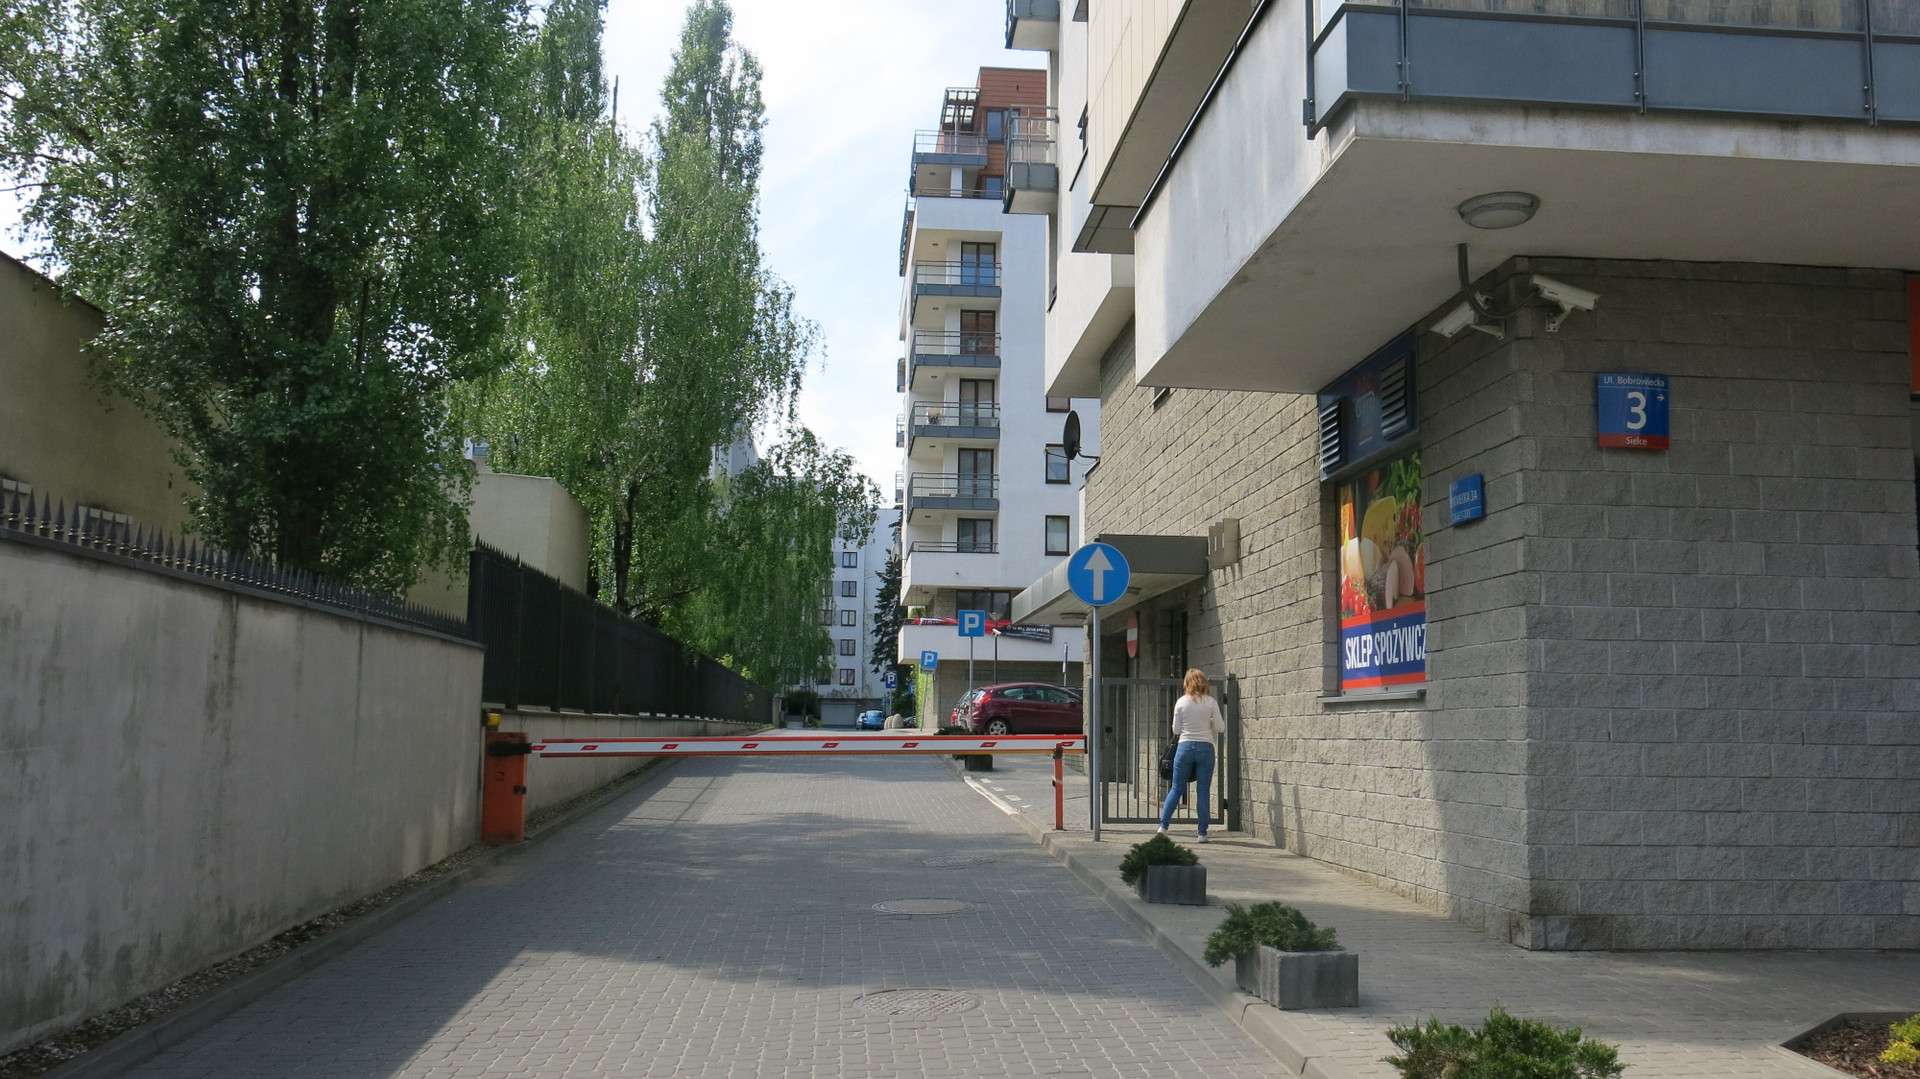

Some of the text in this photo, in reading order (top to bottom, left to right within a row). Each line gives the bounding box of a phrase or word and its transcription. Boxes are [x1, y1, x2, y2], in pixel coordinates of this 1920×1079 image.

[1603, 376, 1665, 387] Ul. Bobrowiecka
[1626, 391, 1647, 430] 3
[1625, 436, 1648, 446] Sielce
[964, 613, 980, 634] P
[923, 652, 935, 666] P
[1345, 634, 1373, 670] SKLEP
[887, 674, 896, 685] P
